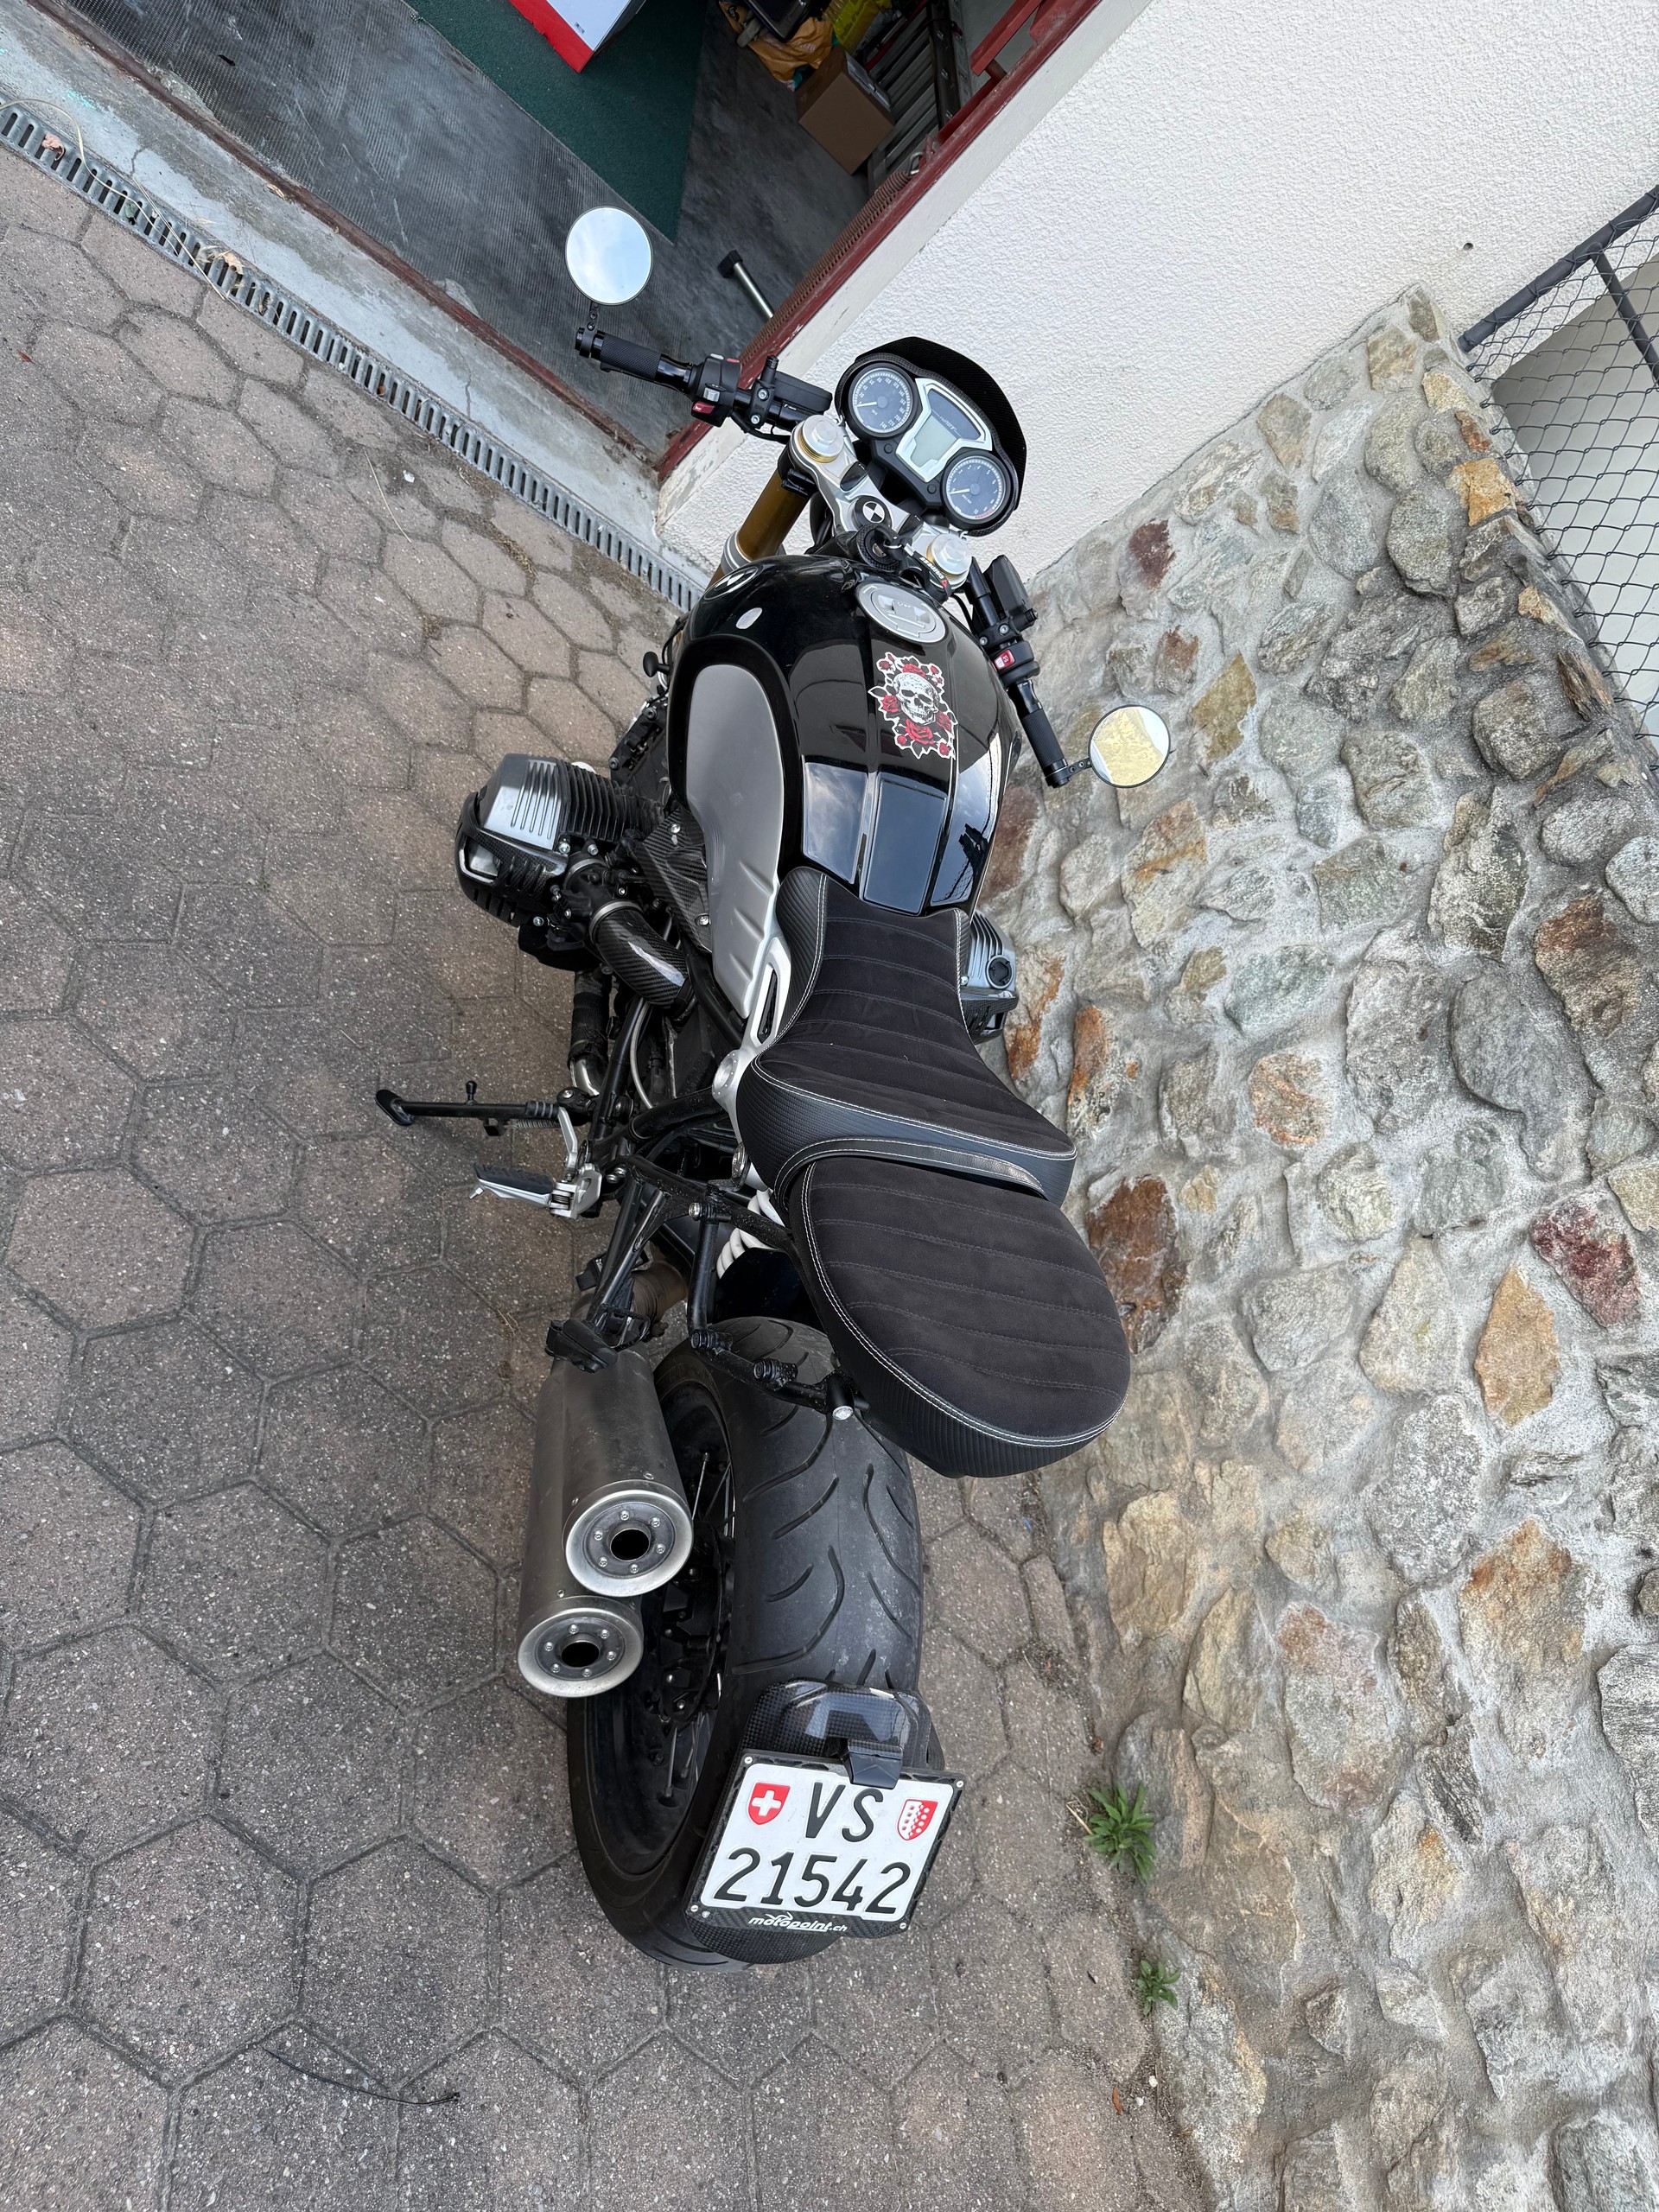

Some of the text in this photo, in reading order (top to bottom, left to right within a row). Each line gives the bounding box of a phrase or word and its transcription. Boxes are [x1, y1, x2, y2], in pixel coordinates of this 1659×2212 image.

[804, 1781, 884, 1843] VS
[713, 1847, 912, 1915] 21542
[748, 1913, 848, 1932] motopoint.ch
